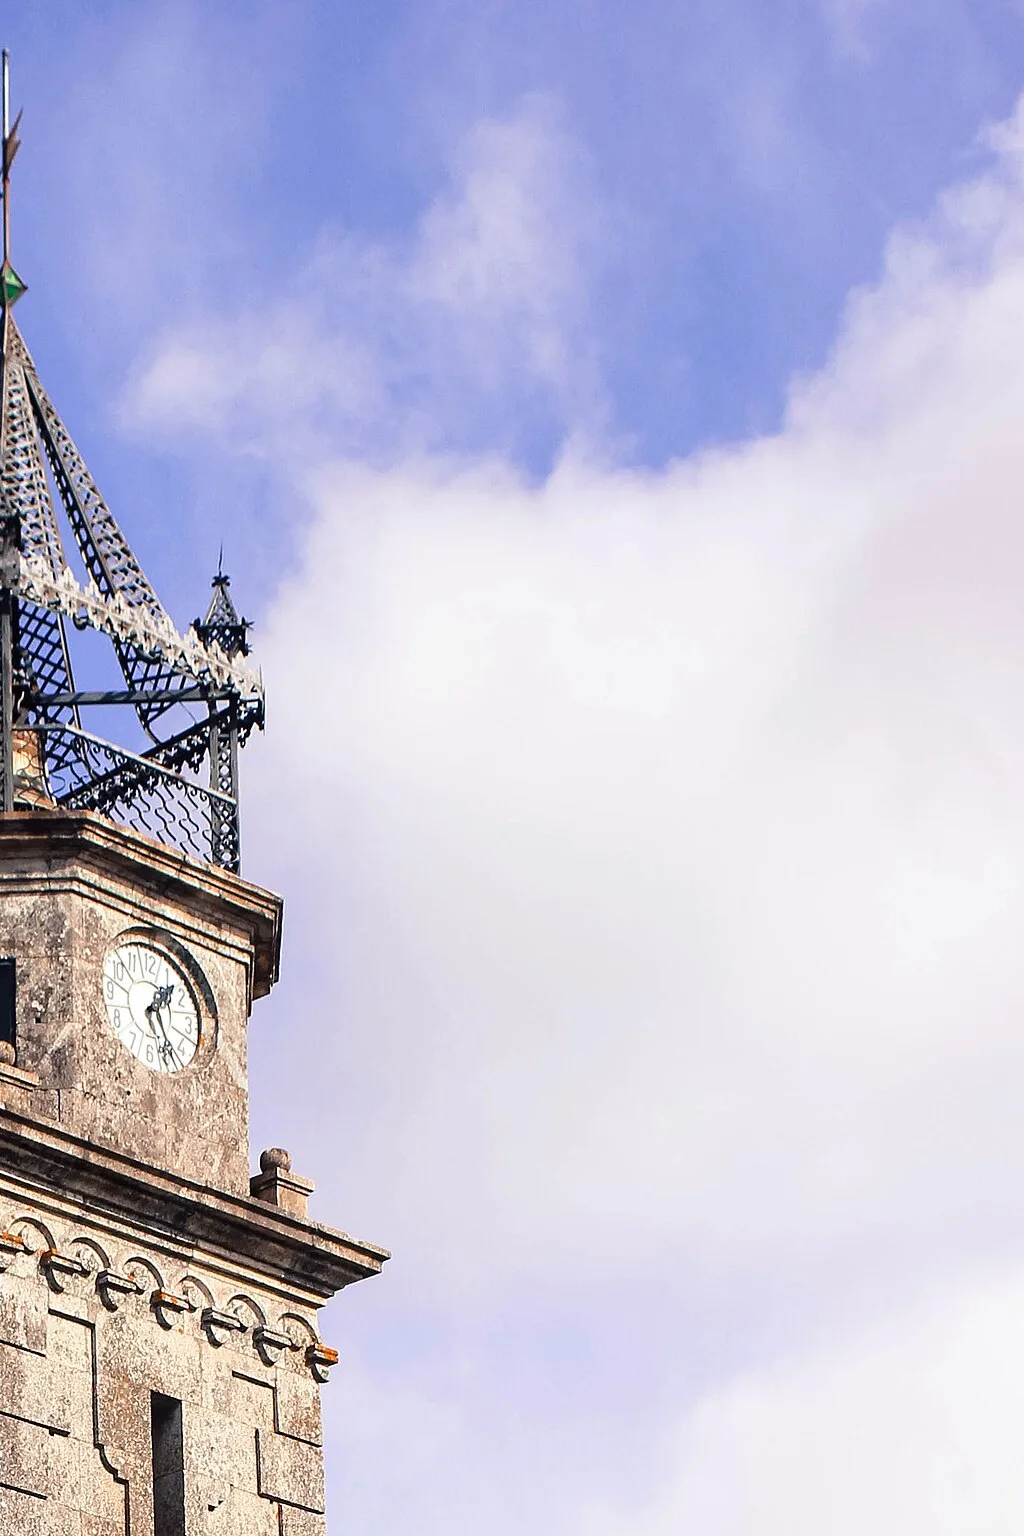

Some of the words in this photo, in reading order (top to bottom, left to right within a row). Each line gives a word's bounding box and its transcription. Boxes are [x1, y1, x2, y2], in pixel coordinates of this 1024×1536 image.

[112, 960, 124, 981] 10
[128, 952, 137, 972] 11
[144, 953, 157, 976] 12
[106, 981, 114, 1000] 9
[178, 988, 186, 1008] 2
[113, 1009, 121, 1028] 8
[185, 1016, 193, 1035] 3
[129, 1032, 137, 1050] 7
[177, 1038, 186, 1057] 4
[145, 1045, 154, 1063] 6
